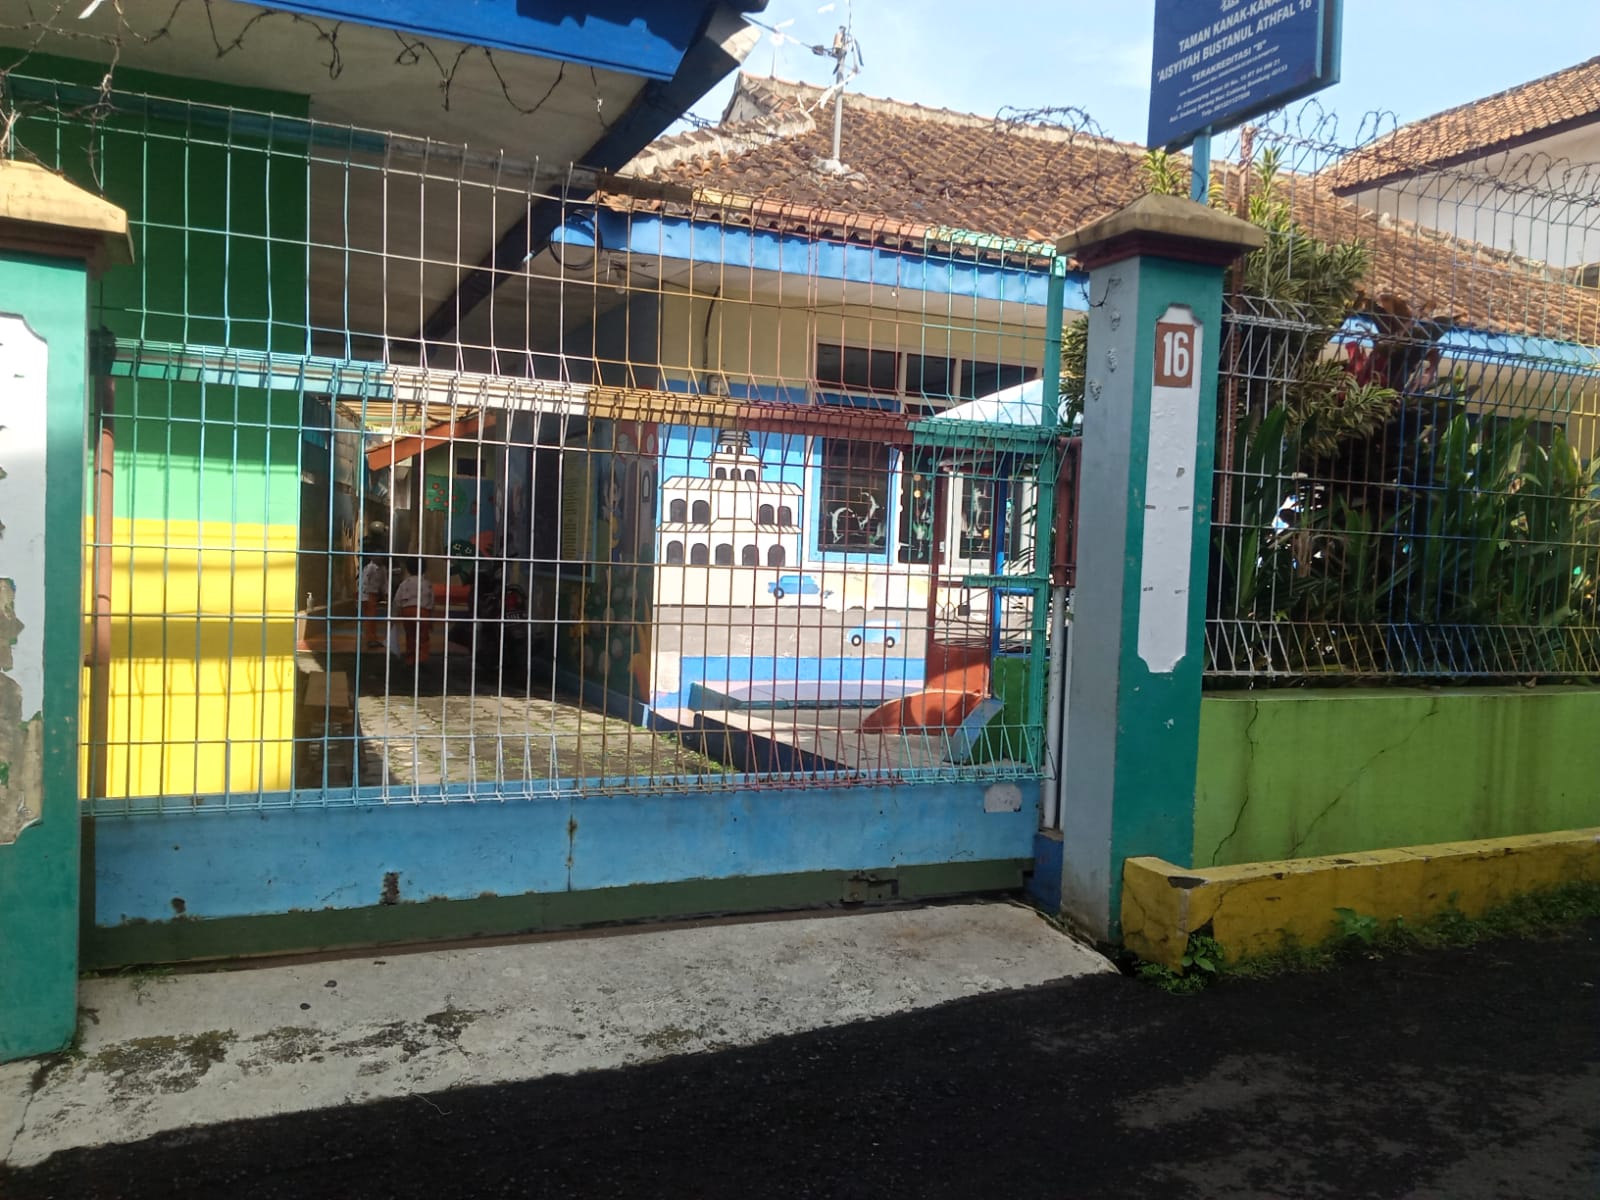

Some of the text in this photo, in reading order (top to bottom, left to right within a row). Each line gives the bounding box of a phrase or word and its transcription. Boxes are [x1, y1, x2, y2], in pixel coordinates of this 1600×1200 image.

[1179, 26, 1211, 53] TAMAN
[1202, 24, 1253, 60] BUSTANUL
[1256, 3, 1296, 34] ATHFAL
[1192, 47, 1251, 82] TERAKREDITASI
[1163, 331, 1190, 377] 16
